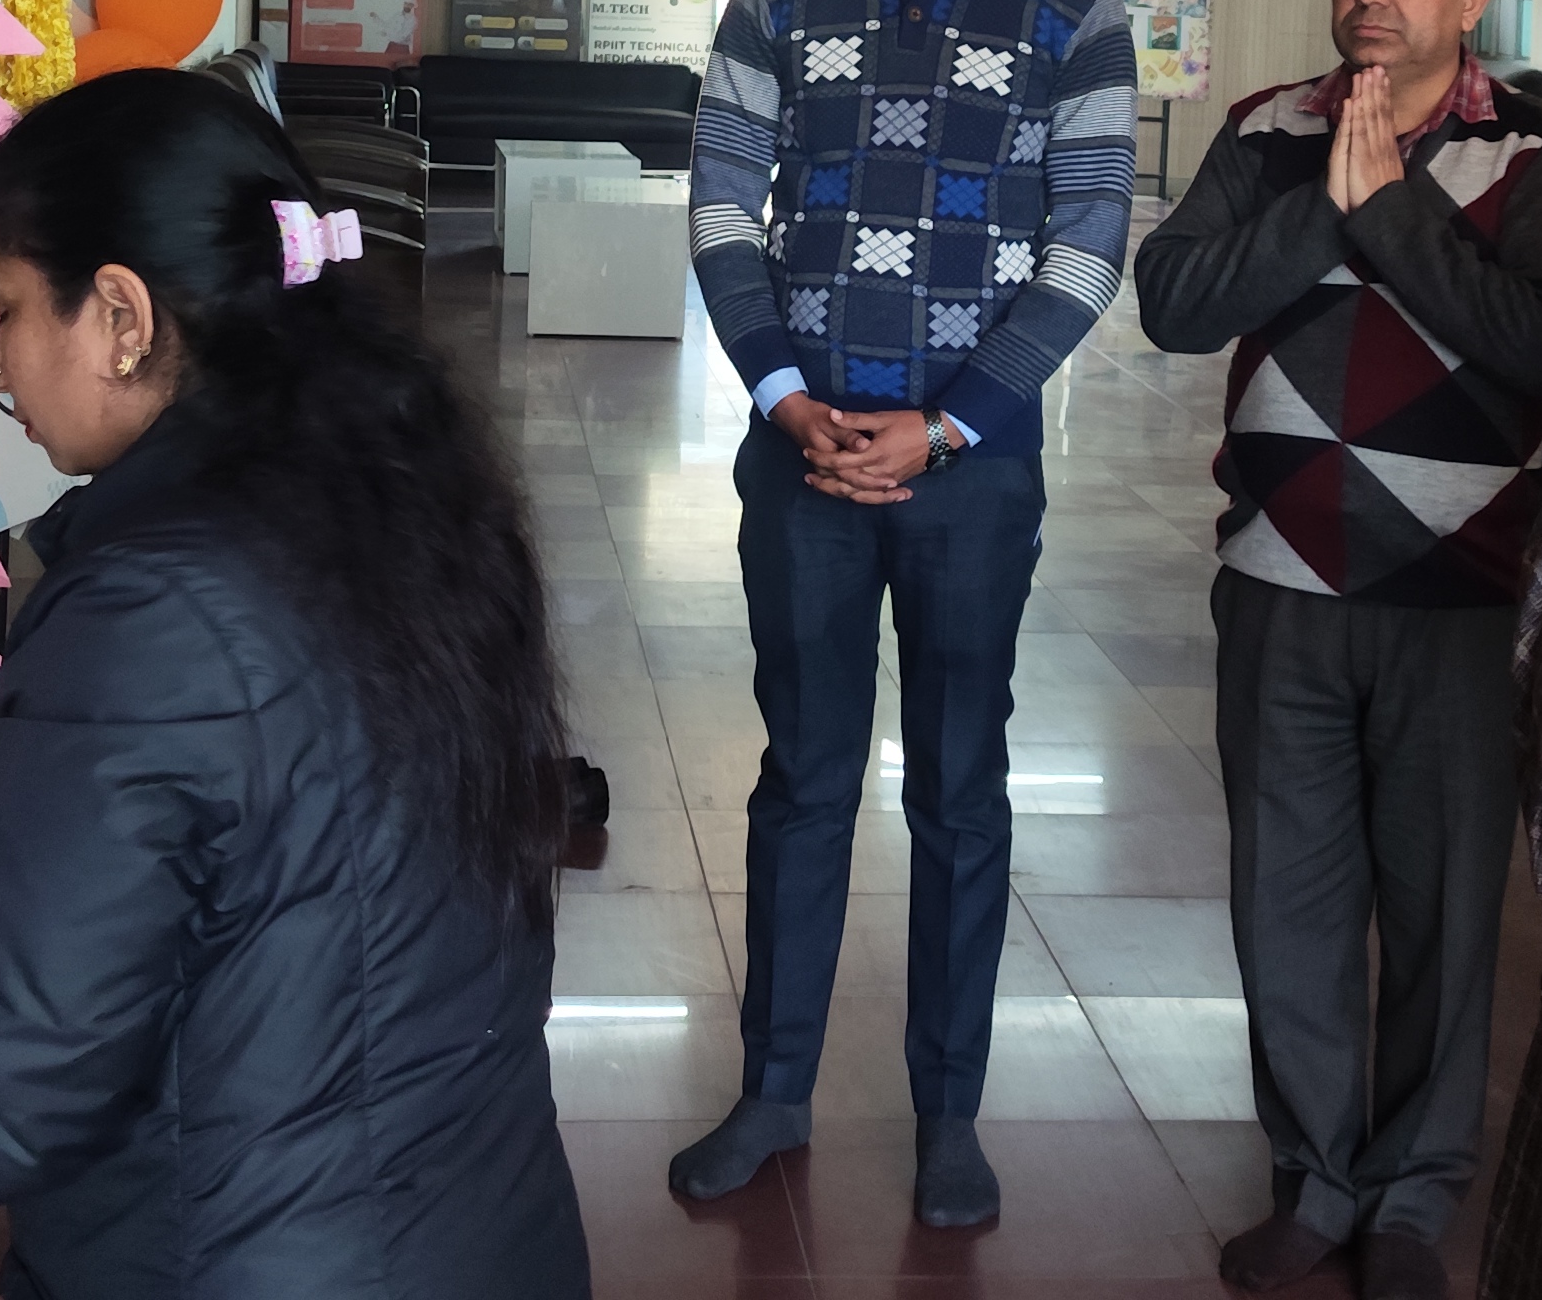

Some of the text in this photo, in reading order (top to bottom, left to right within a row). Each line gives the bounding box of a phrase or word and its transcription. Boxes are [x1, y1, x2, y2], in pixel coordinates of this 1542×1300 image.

[592, 3, 650, 15] M.TECH
[593, 40, 627, 51] RPIIT
[630, 41, 701, 52] TECHNICAL
[593, 53, 706, 66] MEDICAL CAMPUS
